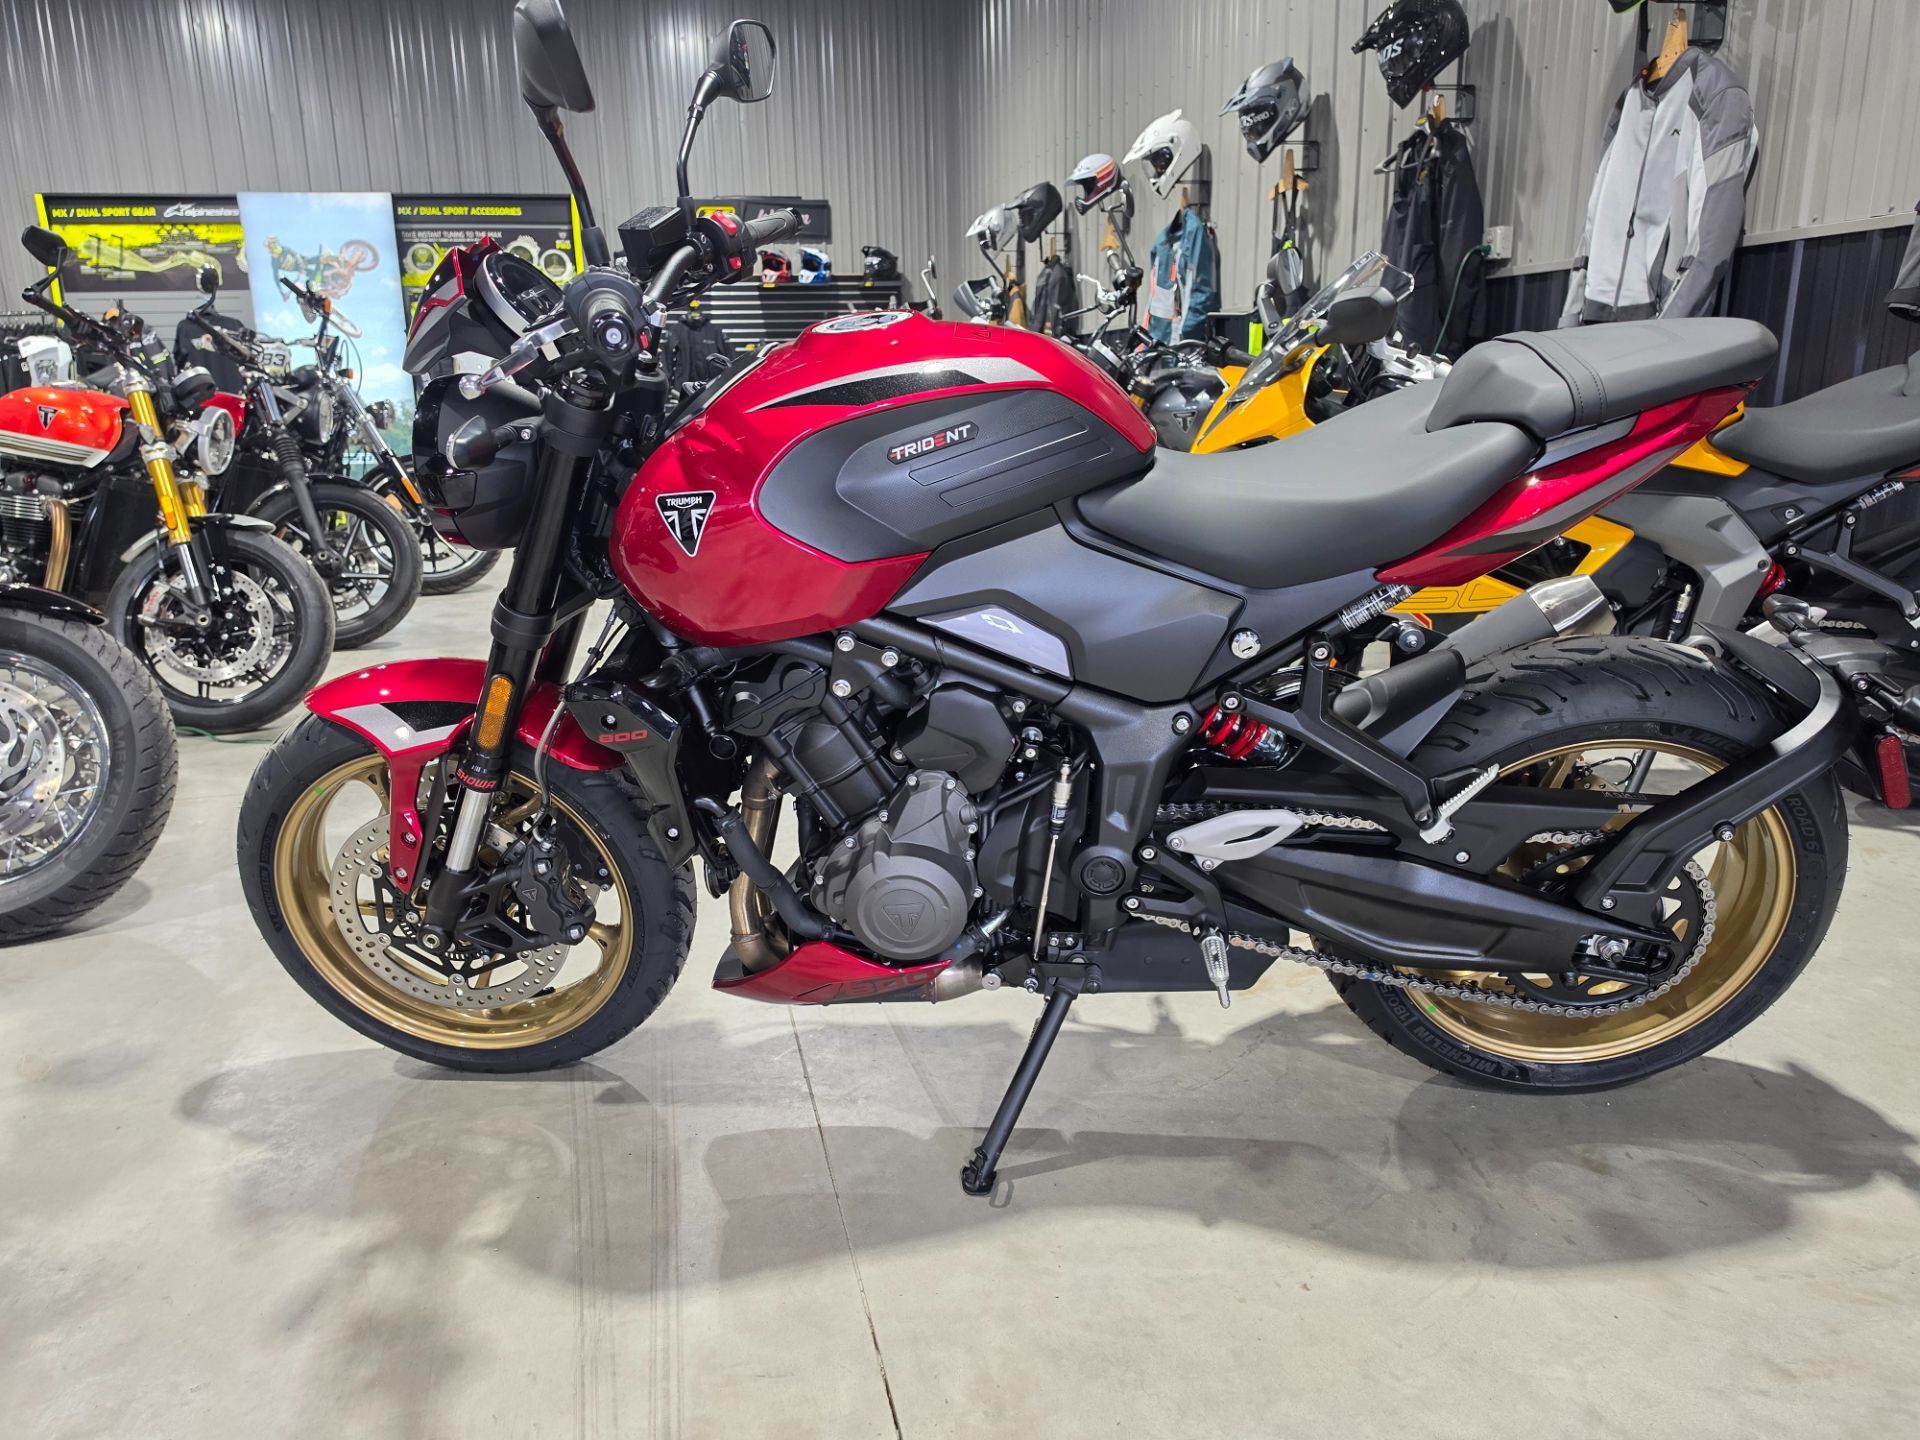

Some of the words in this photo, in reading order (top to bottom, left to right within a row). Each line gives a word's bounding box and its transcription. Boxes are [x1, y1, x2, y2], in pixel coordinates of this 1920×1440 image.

[52, 208, 68, 218] MX
[76, 208, 100, 217] DUAL
[101, 207, 130, 217] SPORT
[131, 207, 156, 217] GEAR
[398, 206, 412, 216] MX
[419, 206, 442, 216] DUAL
[443, 206, 469, 216] SPORT
[470, 206, 522, 216] ACCESSORIES
[890, 424, 971, 460] TRIDENT
[666, 496, 703, 507] TRIUMPH
[456, 768, 497, 790] SHOWA
[1785, 797, 1816, 837] ROAD
[1805, 840, 1820, 850] 6
[1413, 1023, 1499, 1074] MICHELIN
